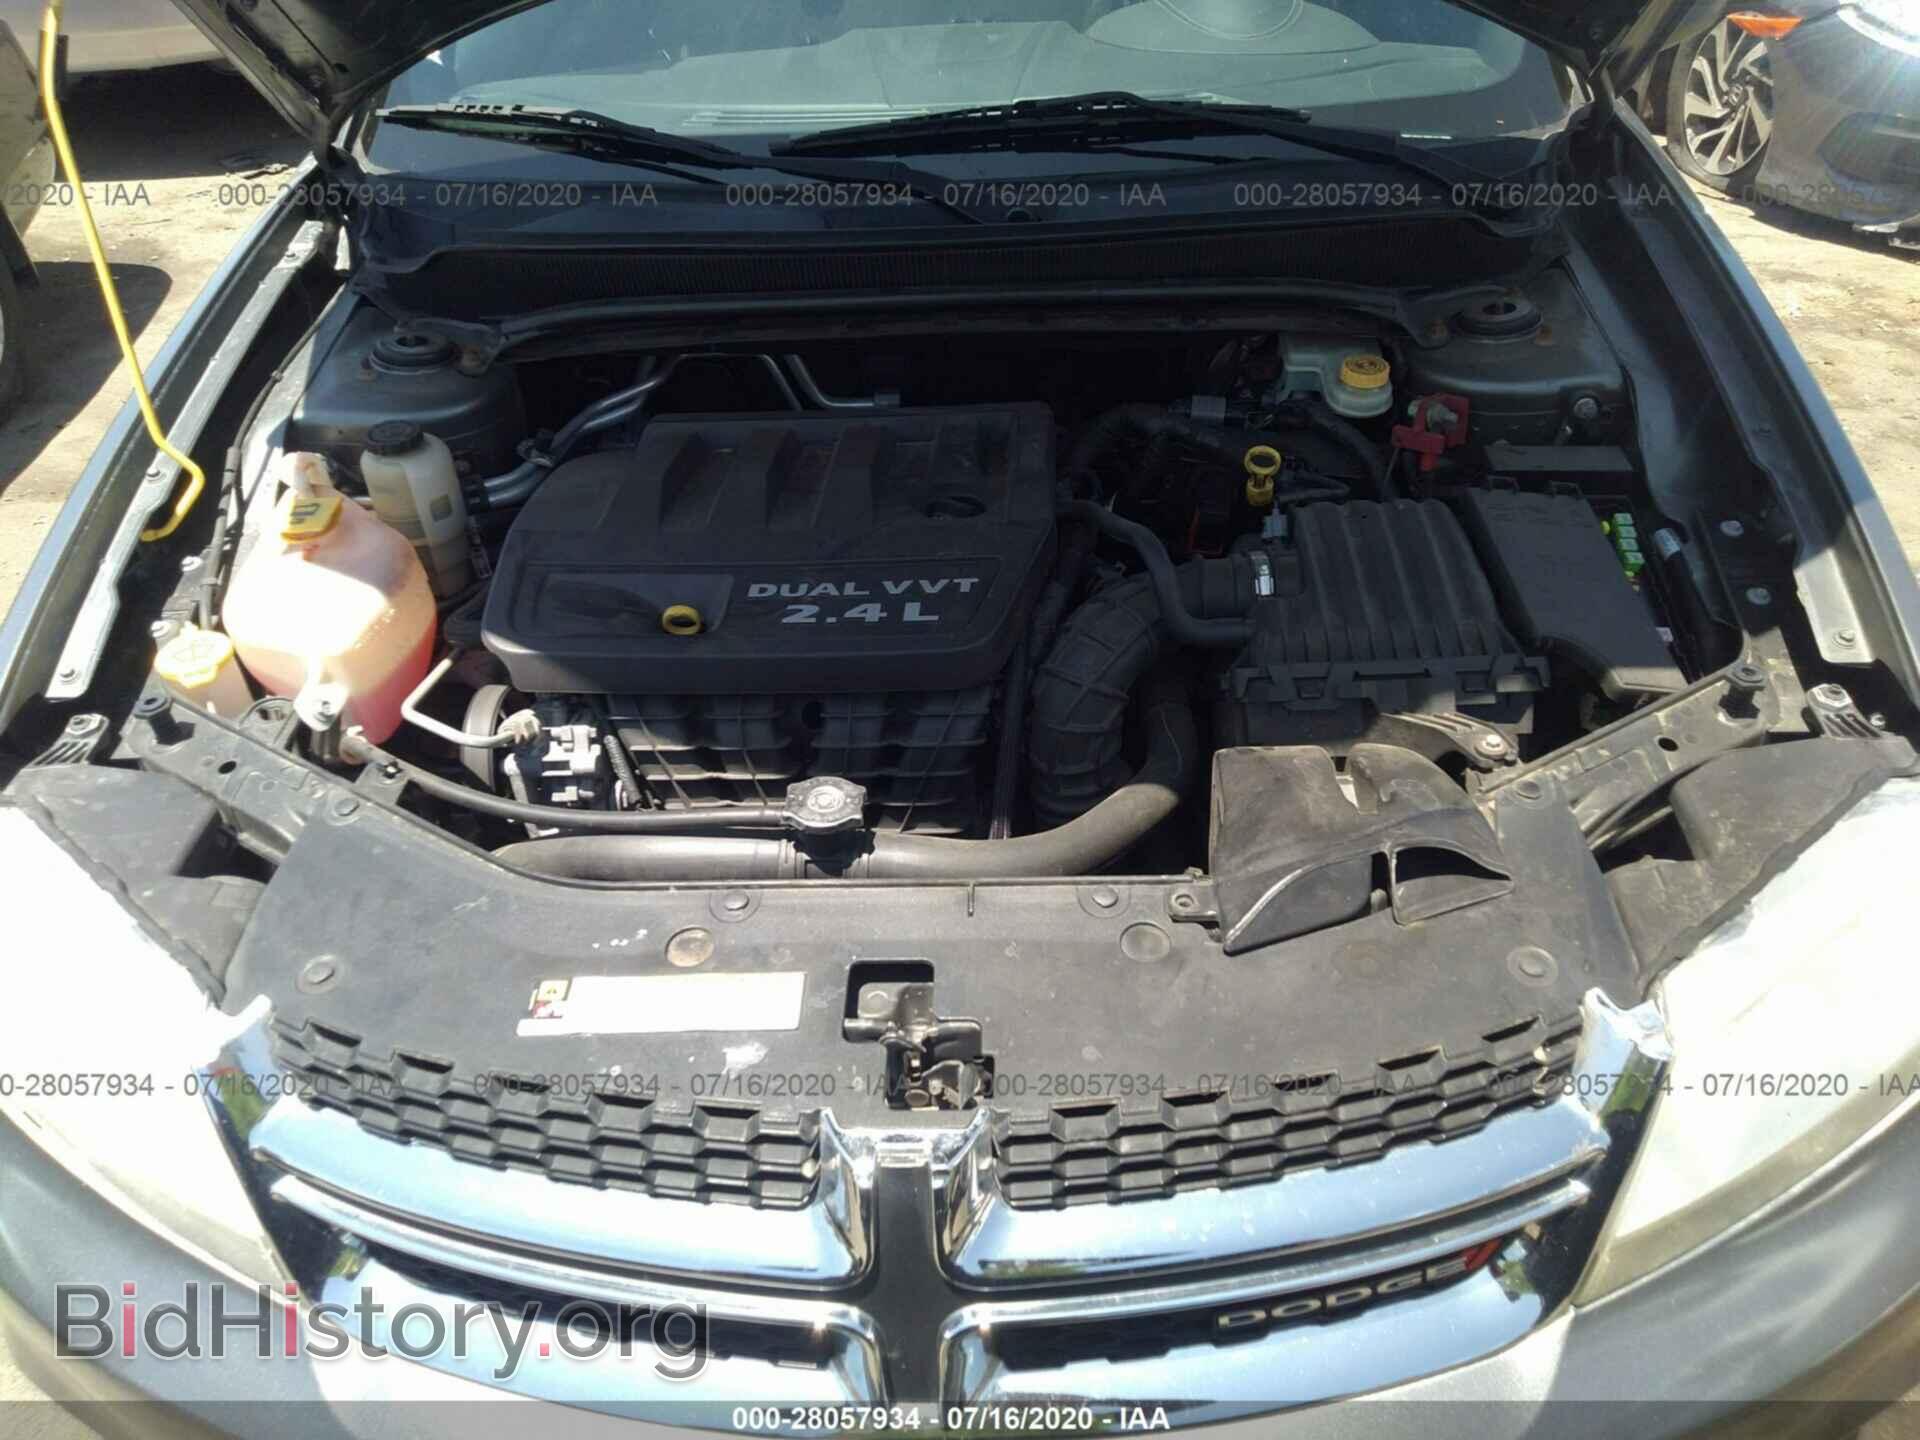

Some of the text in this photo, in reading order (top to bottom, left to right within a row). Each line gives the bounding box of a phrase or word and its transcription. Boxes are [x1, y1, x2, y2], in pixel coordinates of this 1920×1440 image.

[747, 578, 980, 598] DUAL VVT
[781, 601, 940, 624] 2.4 L
[1218, 1256, 1467, 1328] DODGE
